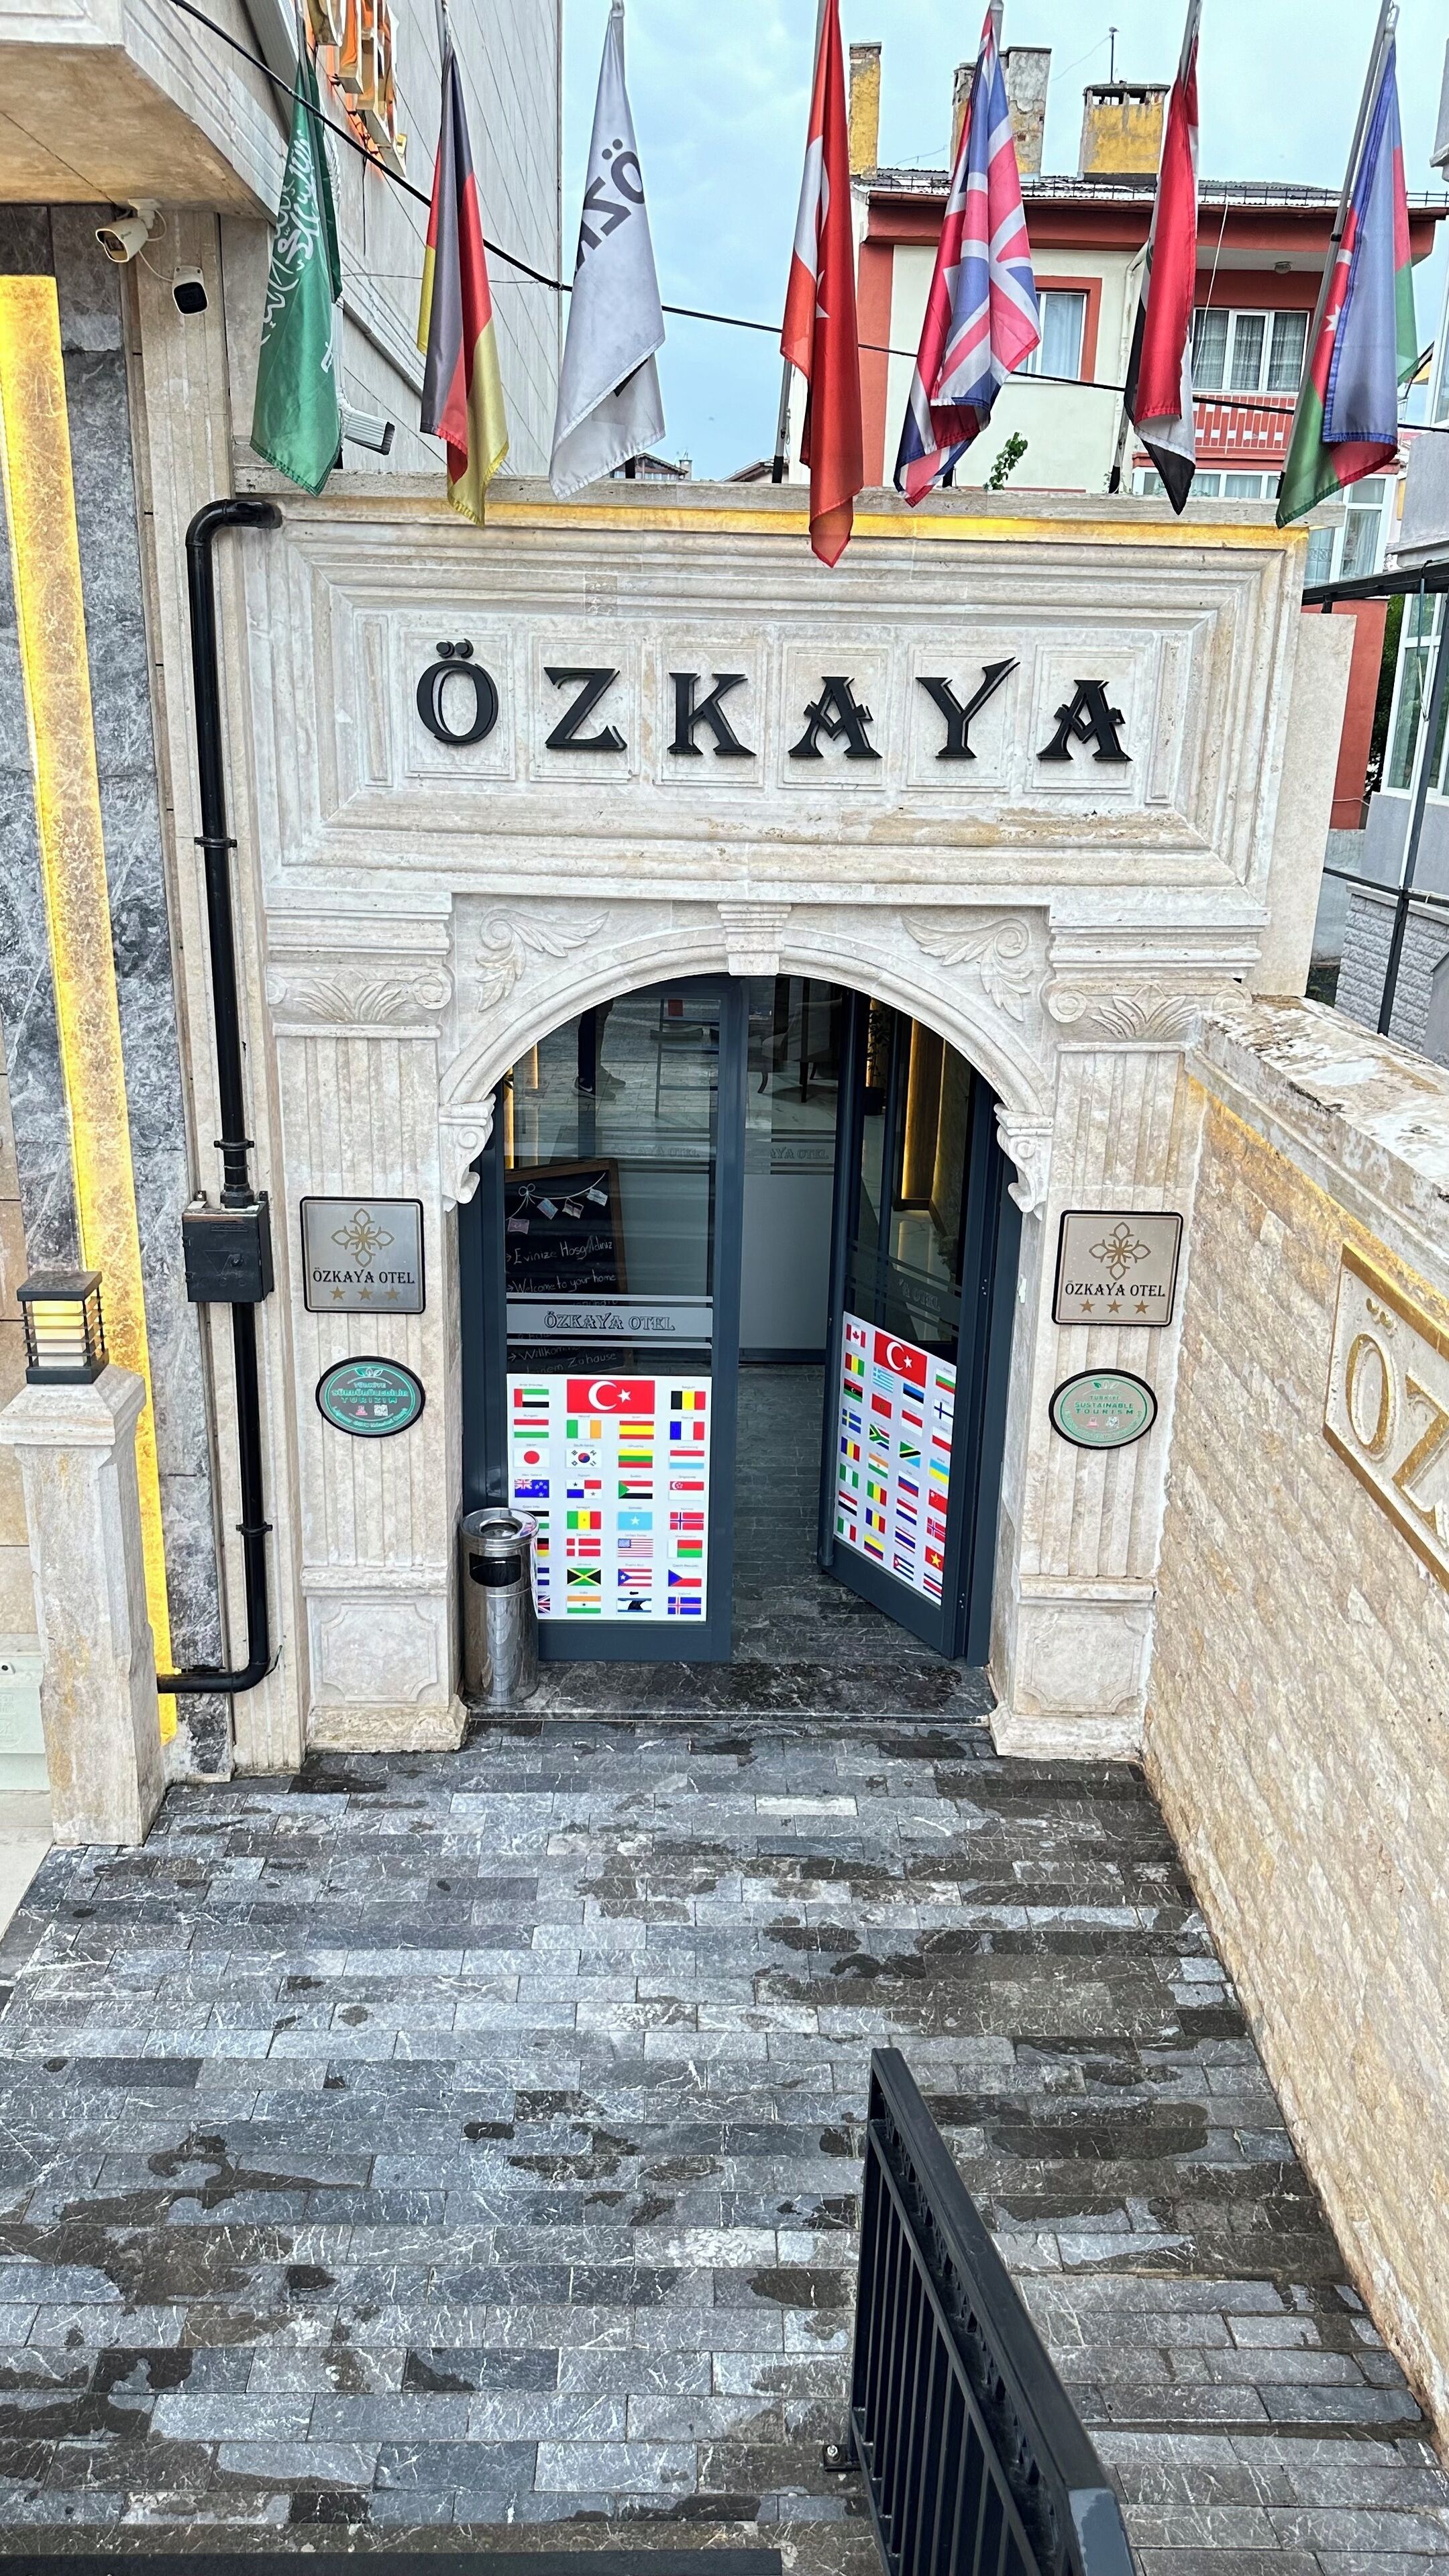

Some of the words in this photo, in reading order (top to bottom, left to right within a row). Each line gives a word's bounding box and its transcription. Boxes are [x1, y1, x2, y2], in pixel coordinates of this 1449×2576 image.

[417, 639, 1134, 762] ÖZKAYA
[313, 1267, 374, 1283] ÖZKAYA
[378, 1271, 415, 1284] OTEL
[556, 1275, 568, 1289] to
[568, 1276, 591, 1292] your
[592, 1269, 616, 1283] home
[1065, 1279, 1126, 1297] ÖZKAYA
[1130, 1284, 1165, 1297] OTEL
[544, 1310, 625, 1330] ÖZKAYA
[628, 1316, 676, 1332] OTEL
